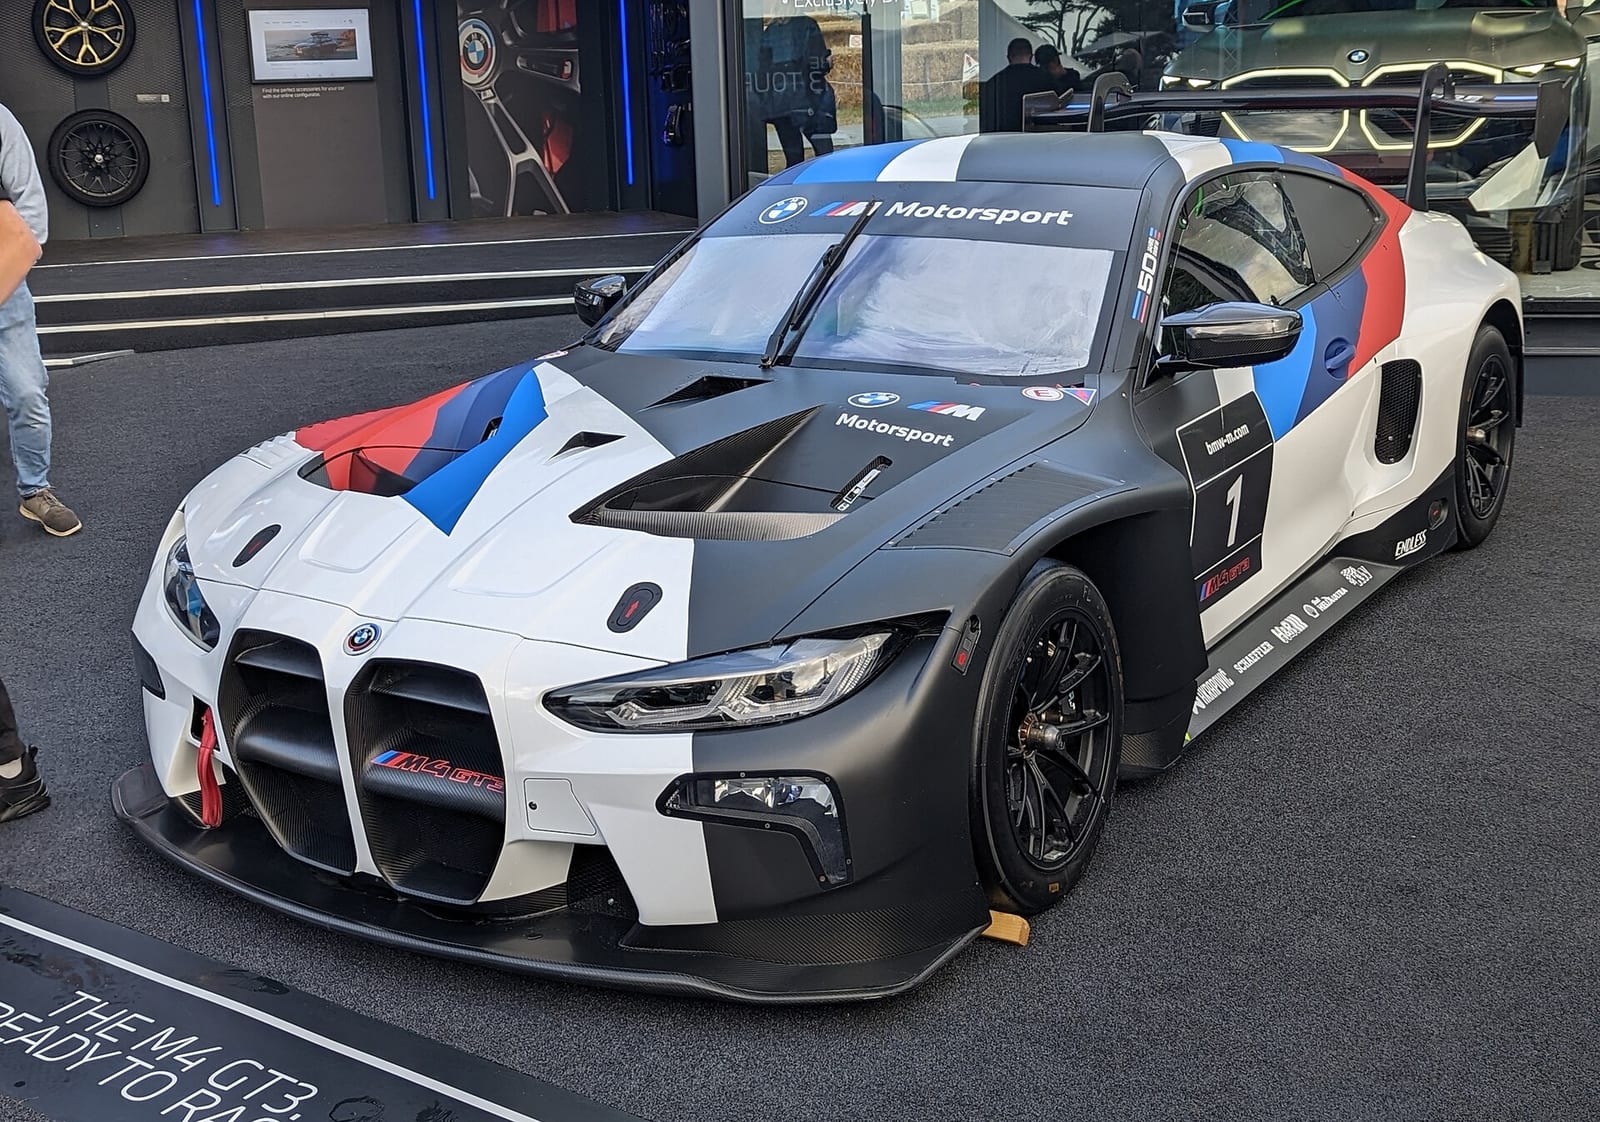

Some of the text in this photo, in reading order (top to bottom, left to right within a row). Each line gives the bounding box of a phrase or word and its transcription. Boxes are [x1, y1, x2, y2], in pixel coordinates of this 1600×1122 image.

[884, 202, 1074, 226] Motorsport
[835, 413, 954, 447] Motorsport
[1205, 423, 1250, 455] bmw-m.com
[1226, 473, 1244, 548] 1
[1395, 529, 1428, 557] ENDLESS
[1233, 641, 1275, 674] SCHAEFFLER
[48, 989, 155, 1043] THE
[130, 1027, 223, 1073] M4
[0, 1002, 280, 1122] EADY TO RA
